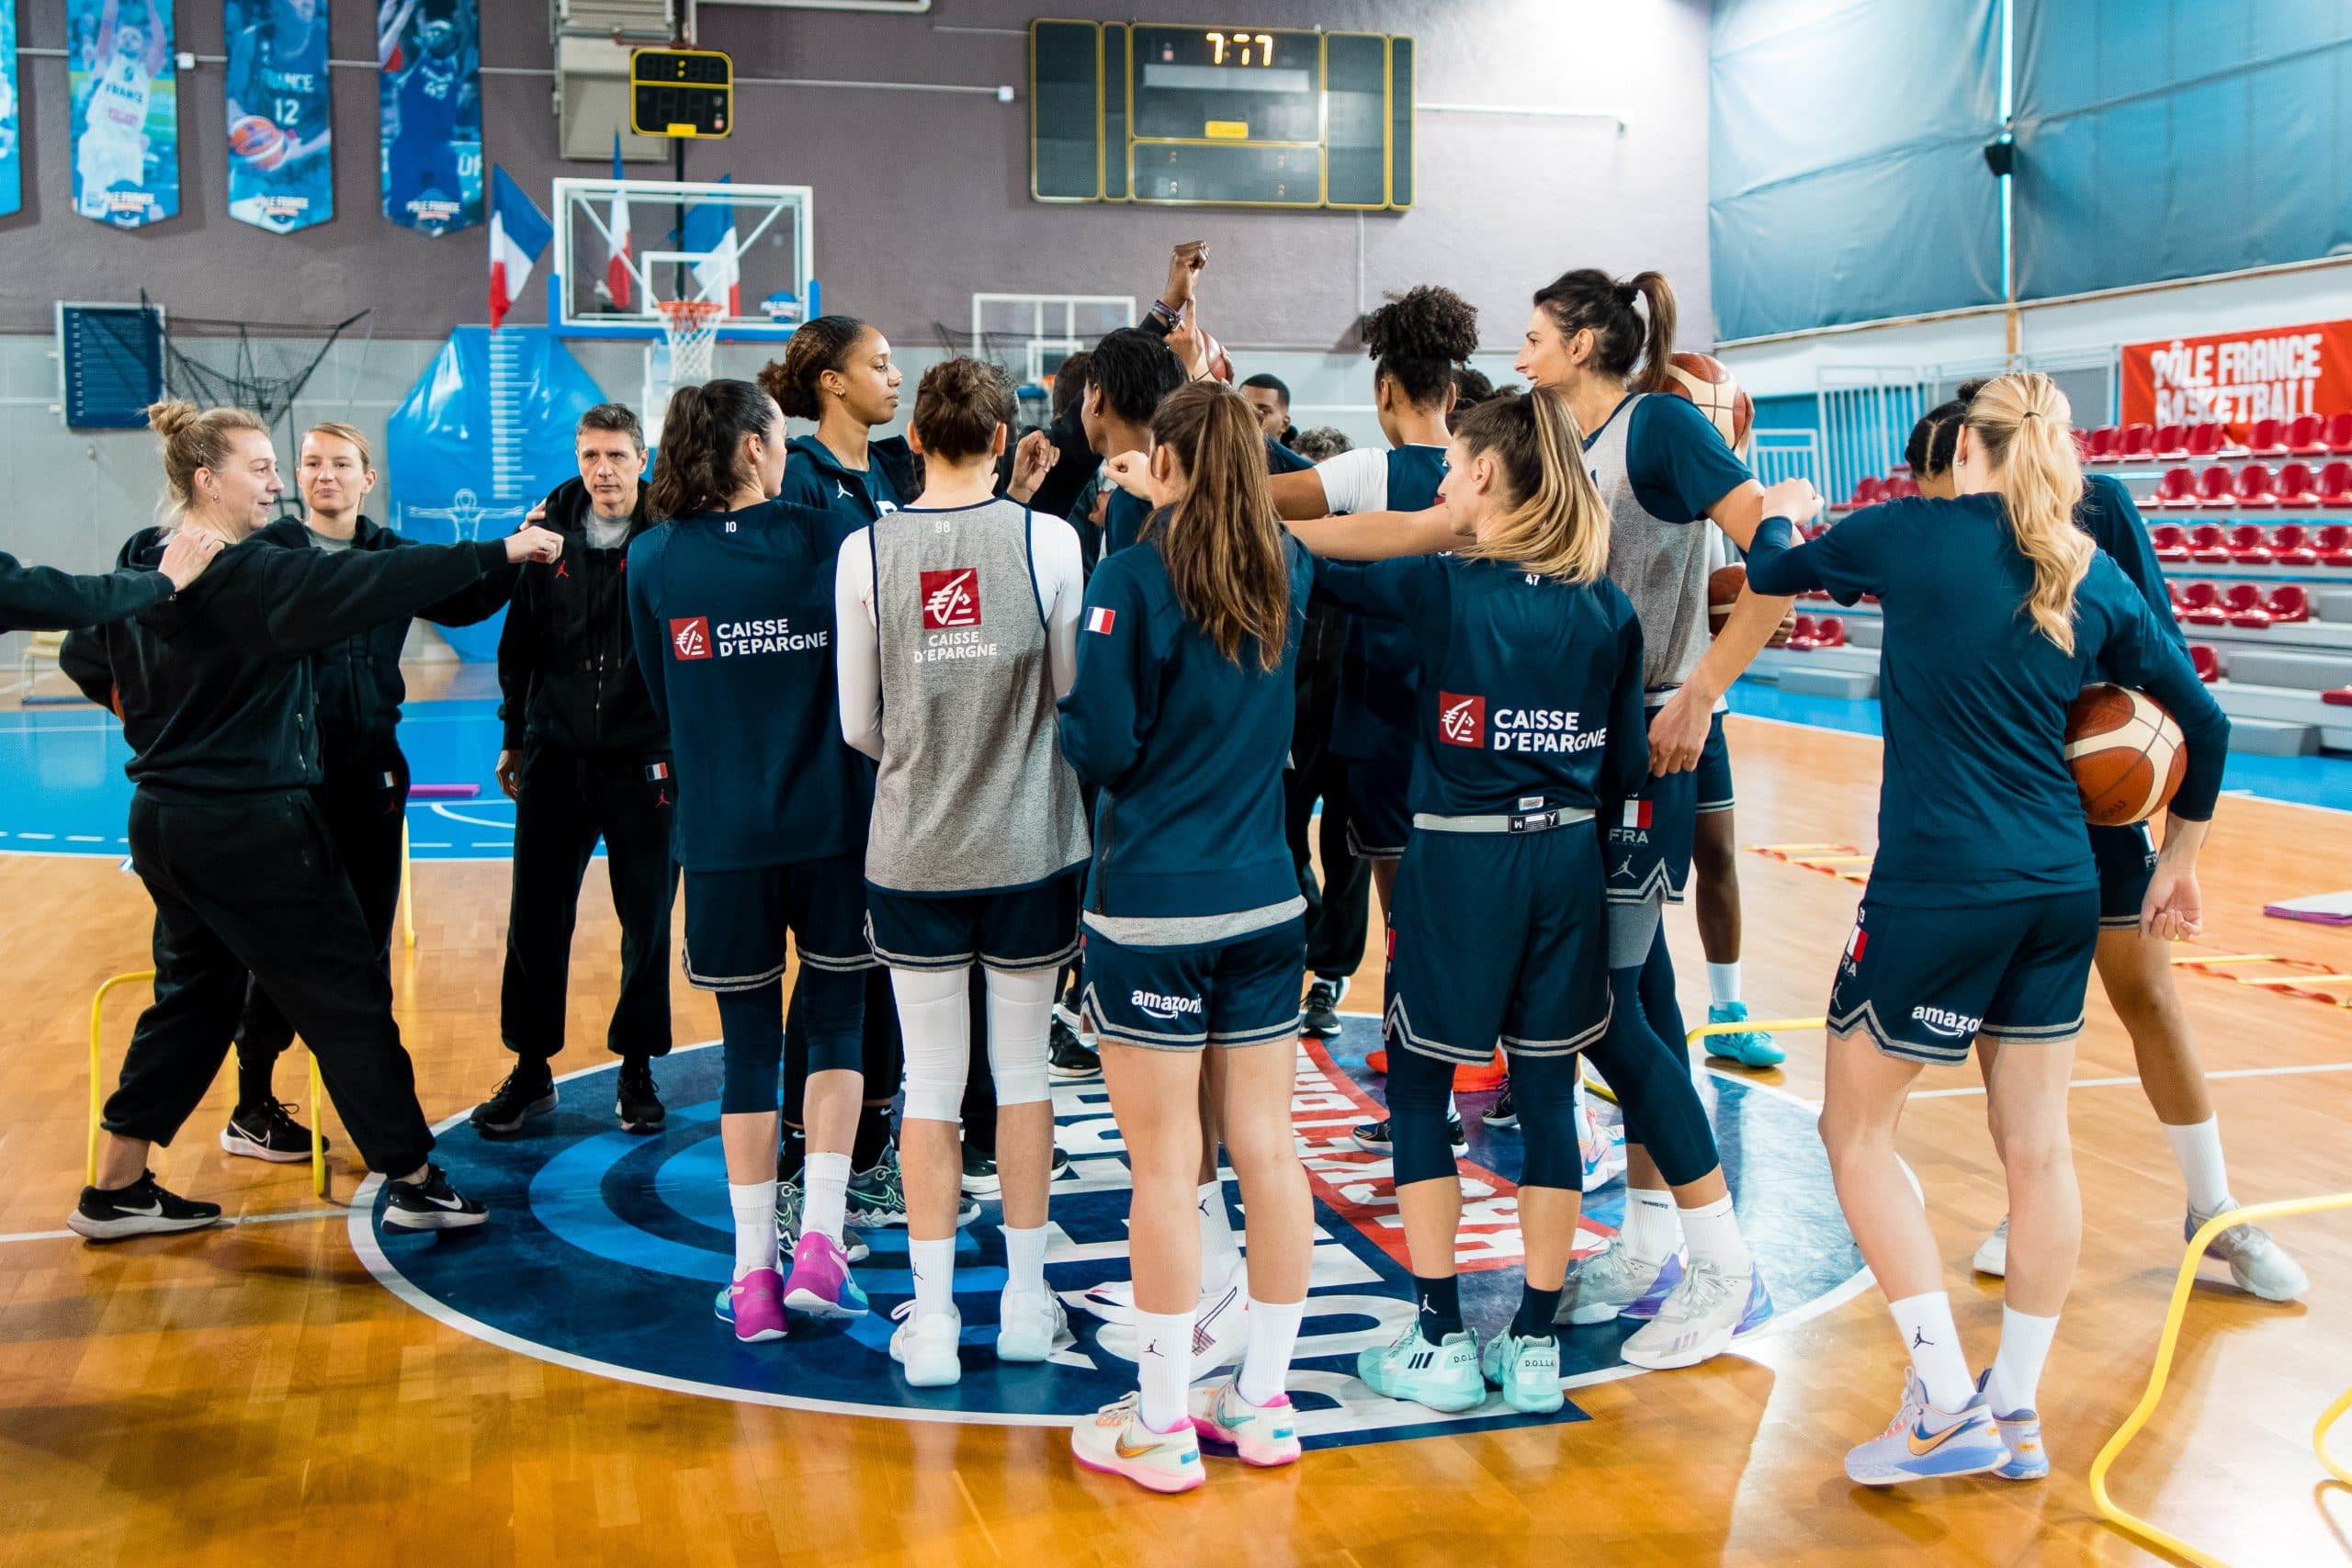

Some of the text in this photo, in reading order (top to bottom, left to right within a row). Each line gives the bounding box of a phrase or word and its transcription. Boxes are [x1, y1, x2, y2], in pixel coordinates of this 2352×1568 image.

[275, 97, 300, 125] 12
[2150, 333, 2324, 389] PÔLE FRANCE
[2155, 378, 2316, 429] BASKETBALL
[724, 521, 738, 534] 10
[1525, 573, 1541, 586] 47
[717, 617, 789, 639] CAISSE
[929, 630, 980, 648] CAISSE
[719, 630, 829, 657] D'EPARGNE
[914, 643, 998, 664] D'EPARGNE
[1494, 709, 1580, 731] CAISSE
[1494, 728, 1607, 753] D'EPARGNE
[1609, 829, 1649, 844] FRA
